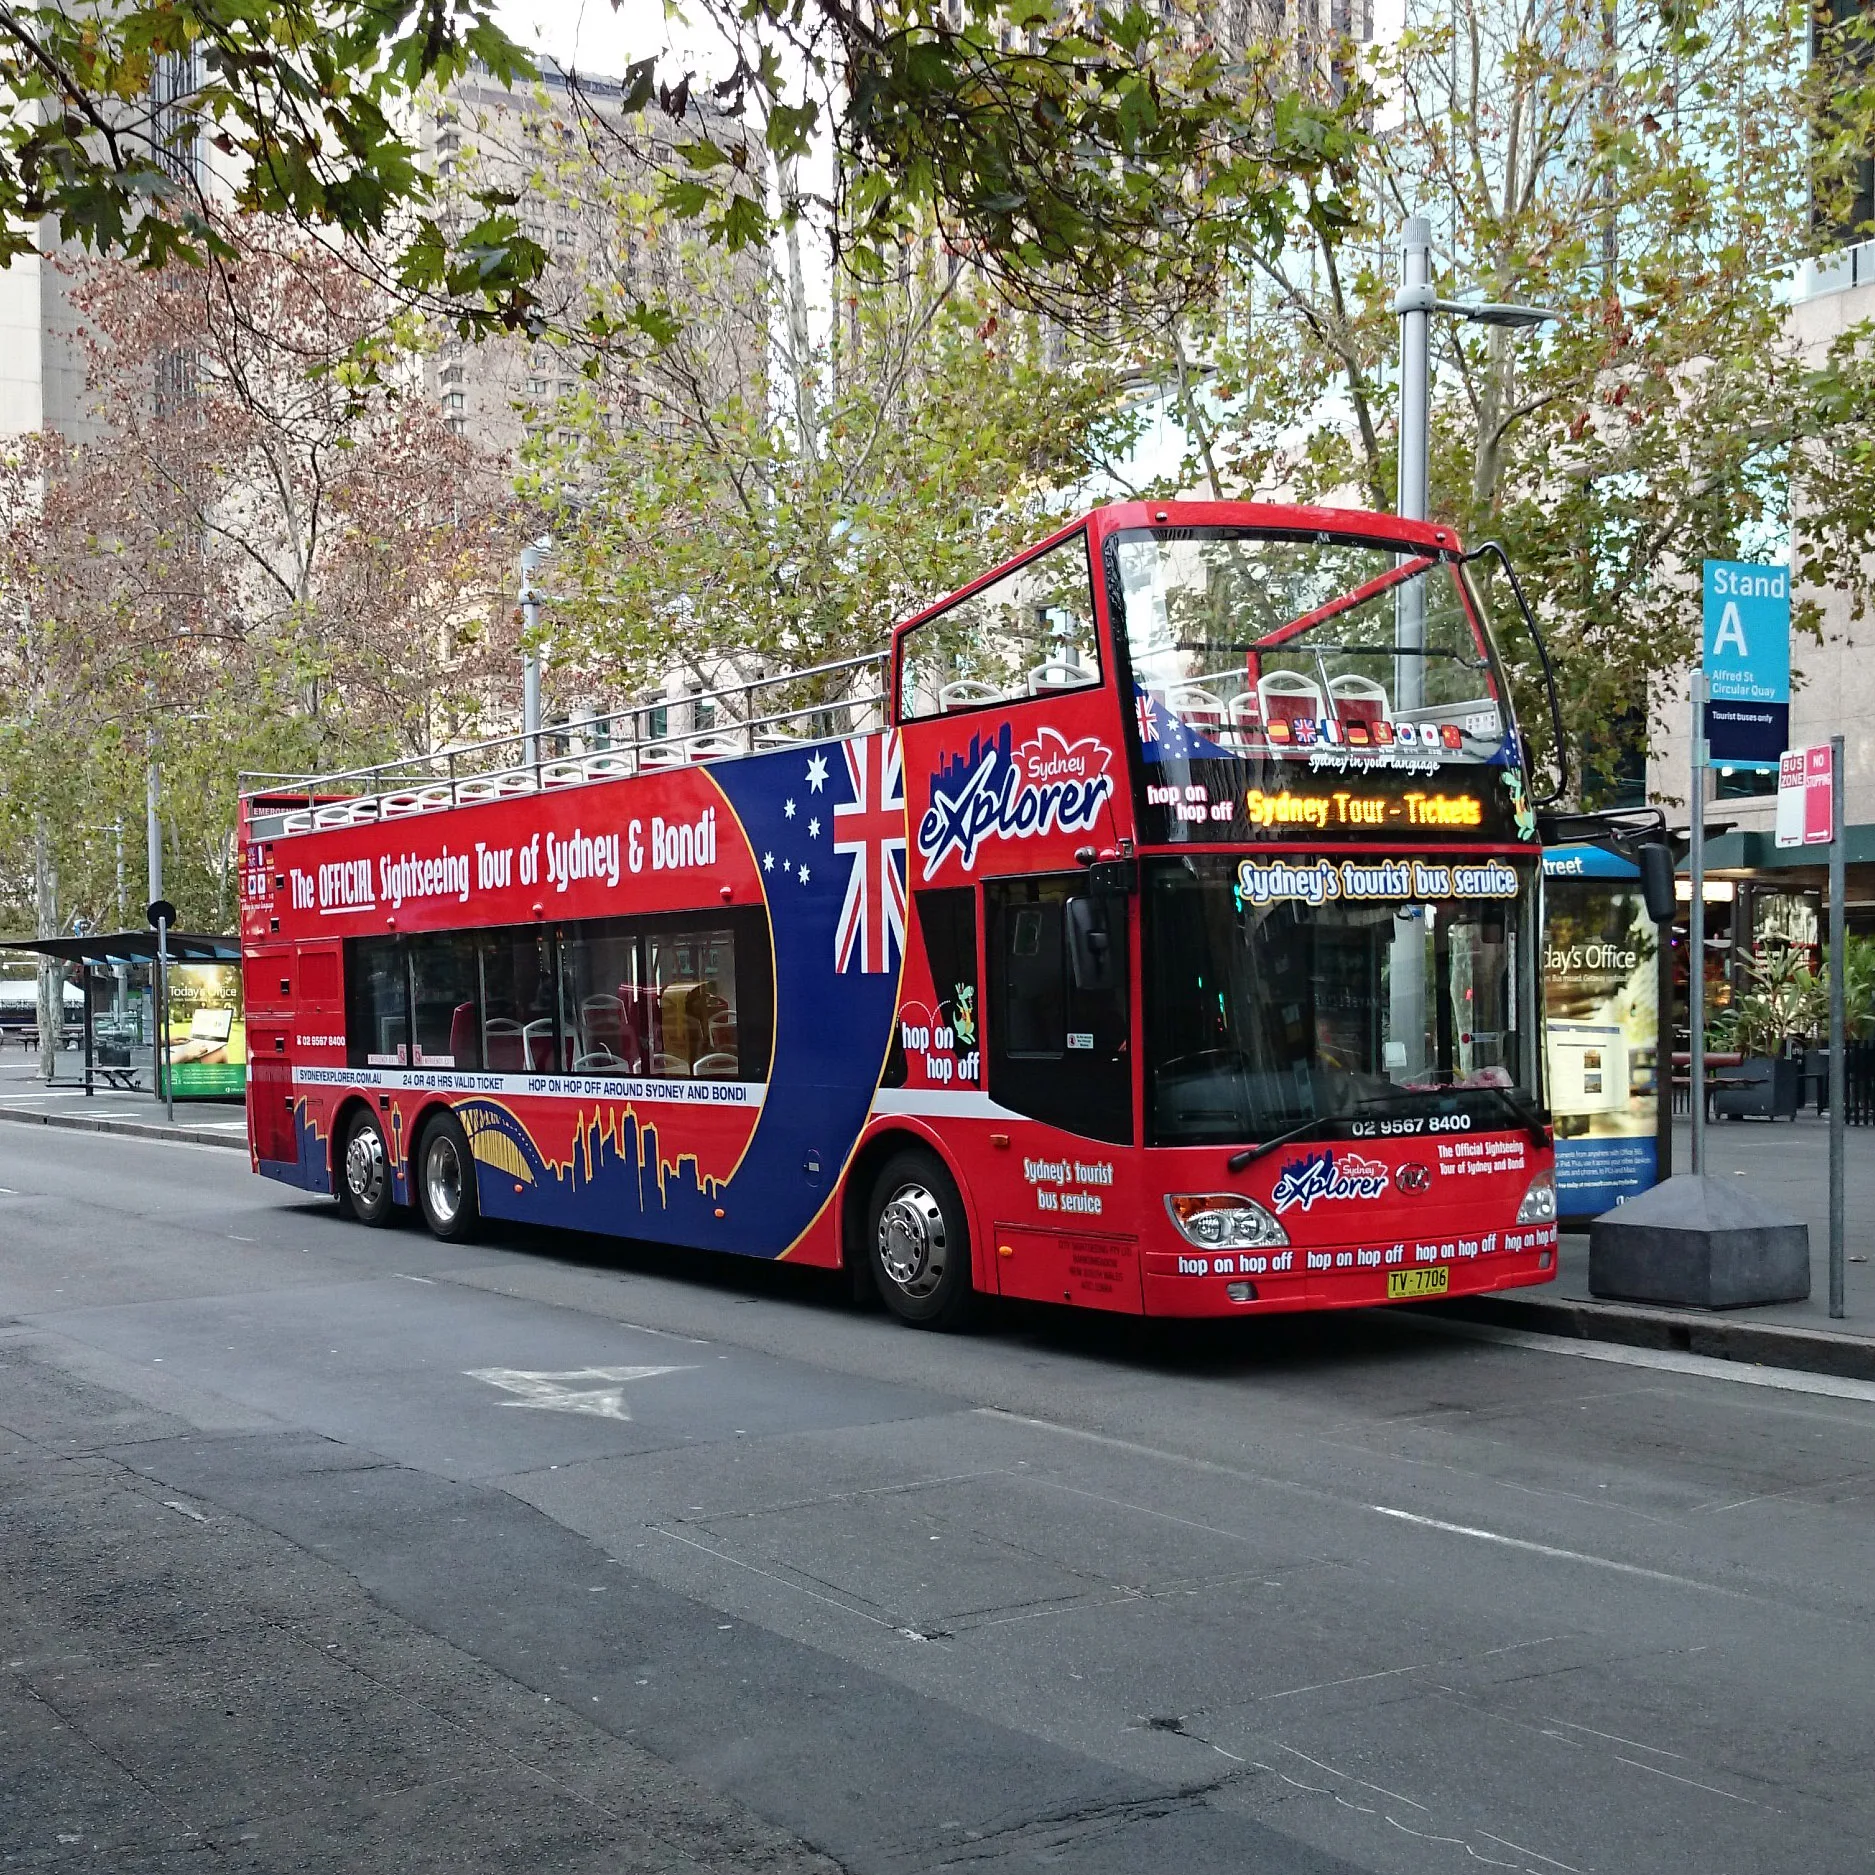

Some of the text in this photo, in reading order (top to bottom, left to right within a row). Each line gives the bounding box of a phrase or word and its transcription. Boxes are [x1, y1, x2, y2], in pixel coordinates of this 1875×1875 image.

[1713, 568, 1785, 598] Stand
[1713, 601, 1748, 656] A
[1712, 670, 1755, 682] Alfred St
[1712, 683, 1775, 699] Circular Quay
[1712, 711, 1773, 724] Tourist buses only
[1028, 752, 1085, 781] Sydney
[1391, 755, 1440, 777] language
[1783, 757, 1803, 772] BUS
[1812, 754, 1824, 767] NO
[1781, 773, 1803, 787] ZONE
[1806, 774, 1831, 788] STOPPING
[1147, 785, 1207, 805] hop on
[1176, 801, 1233, 823] hop off
[1247, 790, 1329, 827] Sydney
[1332, 793, 1386, 824] Tour
[1403, 792, 1482, 825] Tickets
[290, 806, 716, 909] The OFFICIAL Sightseeing Tour of Sydney & Bondi
[1543, 857, 1584, 876] treet
[1240, 860, 1519, 905] Sydney's tourist bus service
[1544, 944, 1636, 974] day's Office
[302, 1035, 311, 1046] 02
[329, 1035, 345, 1046] 8400
[902, 1021, 954, 1054] hop on
[299, 1070, 382, 1084] SYDNEYEXPLORER.COM.AU
[926, 1051, 980, 1085] hop off
[403, 1074, 504, 1090] 24 OR 48 HRS VALID TICKET
[528, 1078, 747, 1101] HOP ON HOP OFF AROUND SYDNEY AND BONDI
[1352, 1114, 1471, 1136] 02 9567 8400
[1437, 1140, 1524, 1158] The Official Sightseeing
[1024, 1157, 1113, 1186] Sydney's tourist
[1342, 1164, 1374, 1177] Sydney
[1439, 1156, 1525, 1176] Tour of Sydney and Bondi
[1037, 1187, 1102, 1214] bus service
[1416, 1233, 1497, 1262] hop on hop off
[1505, 1234, 1521, 1252] hop
[1524, 1233, 1534, 1246] on
[1536, 1228, 1548, 1246] hop
[1178, 1251, 1293, 1276] hop on hop off
[1307, 1244, 1403, 1270] hop on hop off
